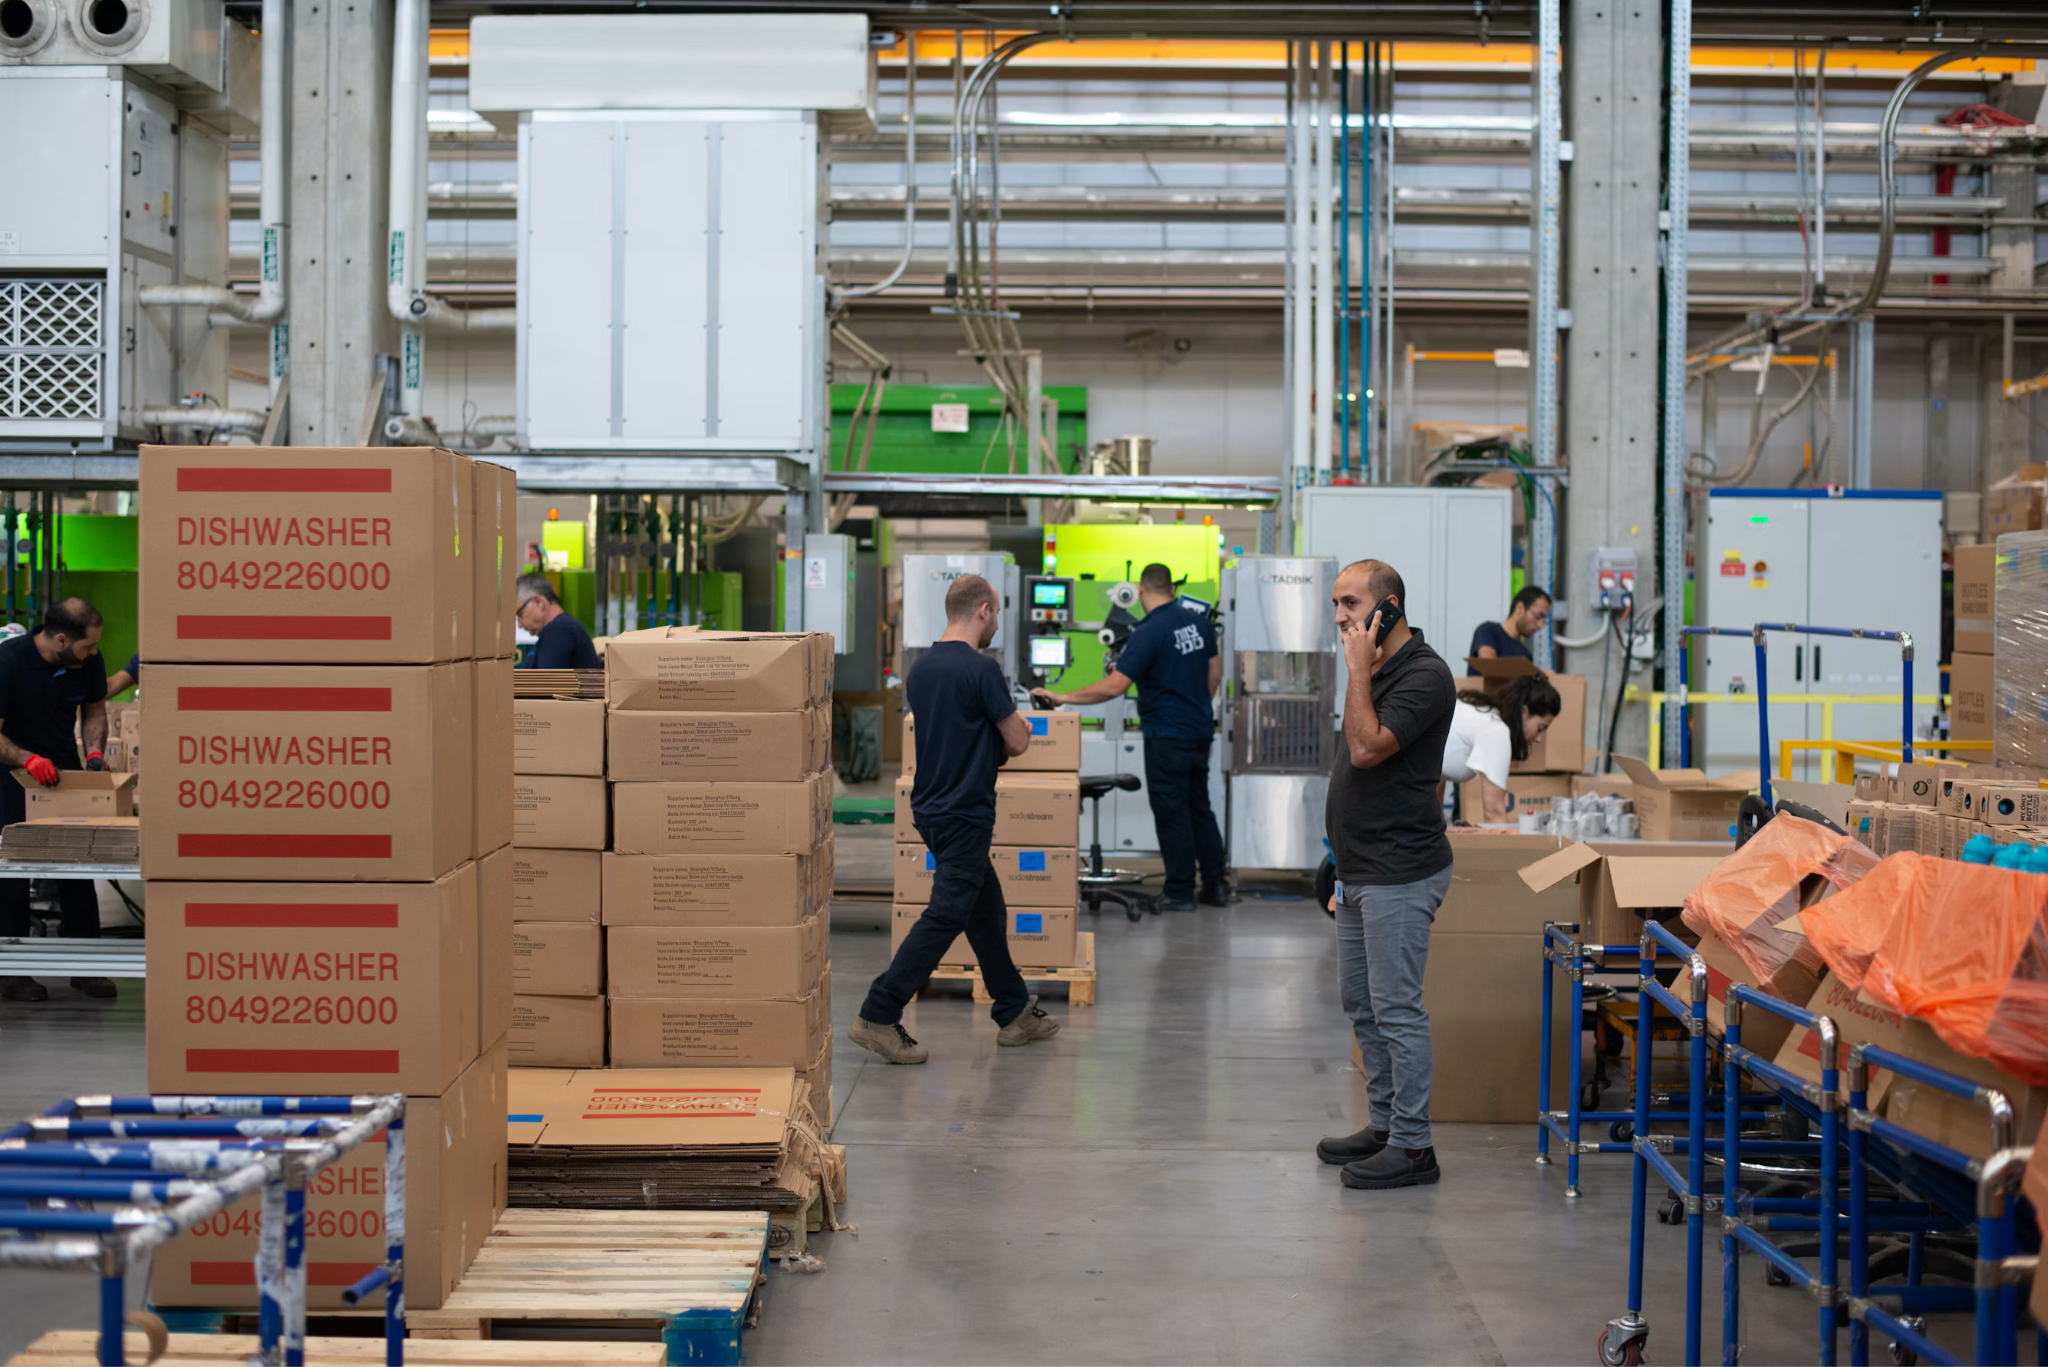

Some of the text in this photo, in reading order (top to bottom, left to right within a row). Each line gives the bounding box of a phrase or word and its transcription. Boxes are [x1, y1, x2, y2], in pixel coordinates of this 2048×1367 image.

[177, 517, 392, 547] DISHWASHER
[177, 560, 391, 591] 8049226000
[1272, 576, 1313, 585] TADBIK
[1962, 583, 1988, 598] BOTTLES
[1958, 690, 1984, 708] BOTTLES
[179, 735, 392, 765] DISHWASHER
[178, 779, 391, 810] 8049226000
[1009, 811, 1053, 821] sodastream
[1007, 873, 1052, 882] sodastream
[186, 951, 399, 982] DISHWASHER
[186, 995, 398, 1025] 8049226000
